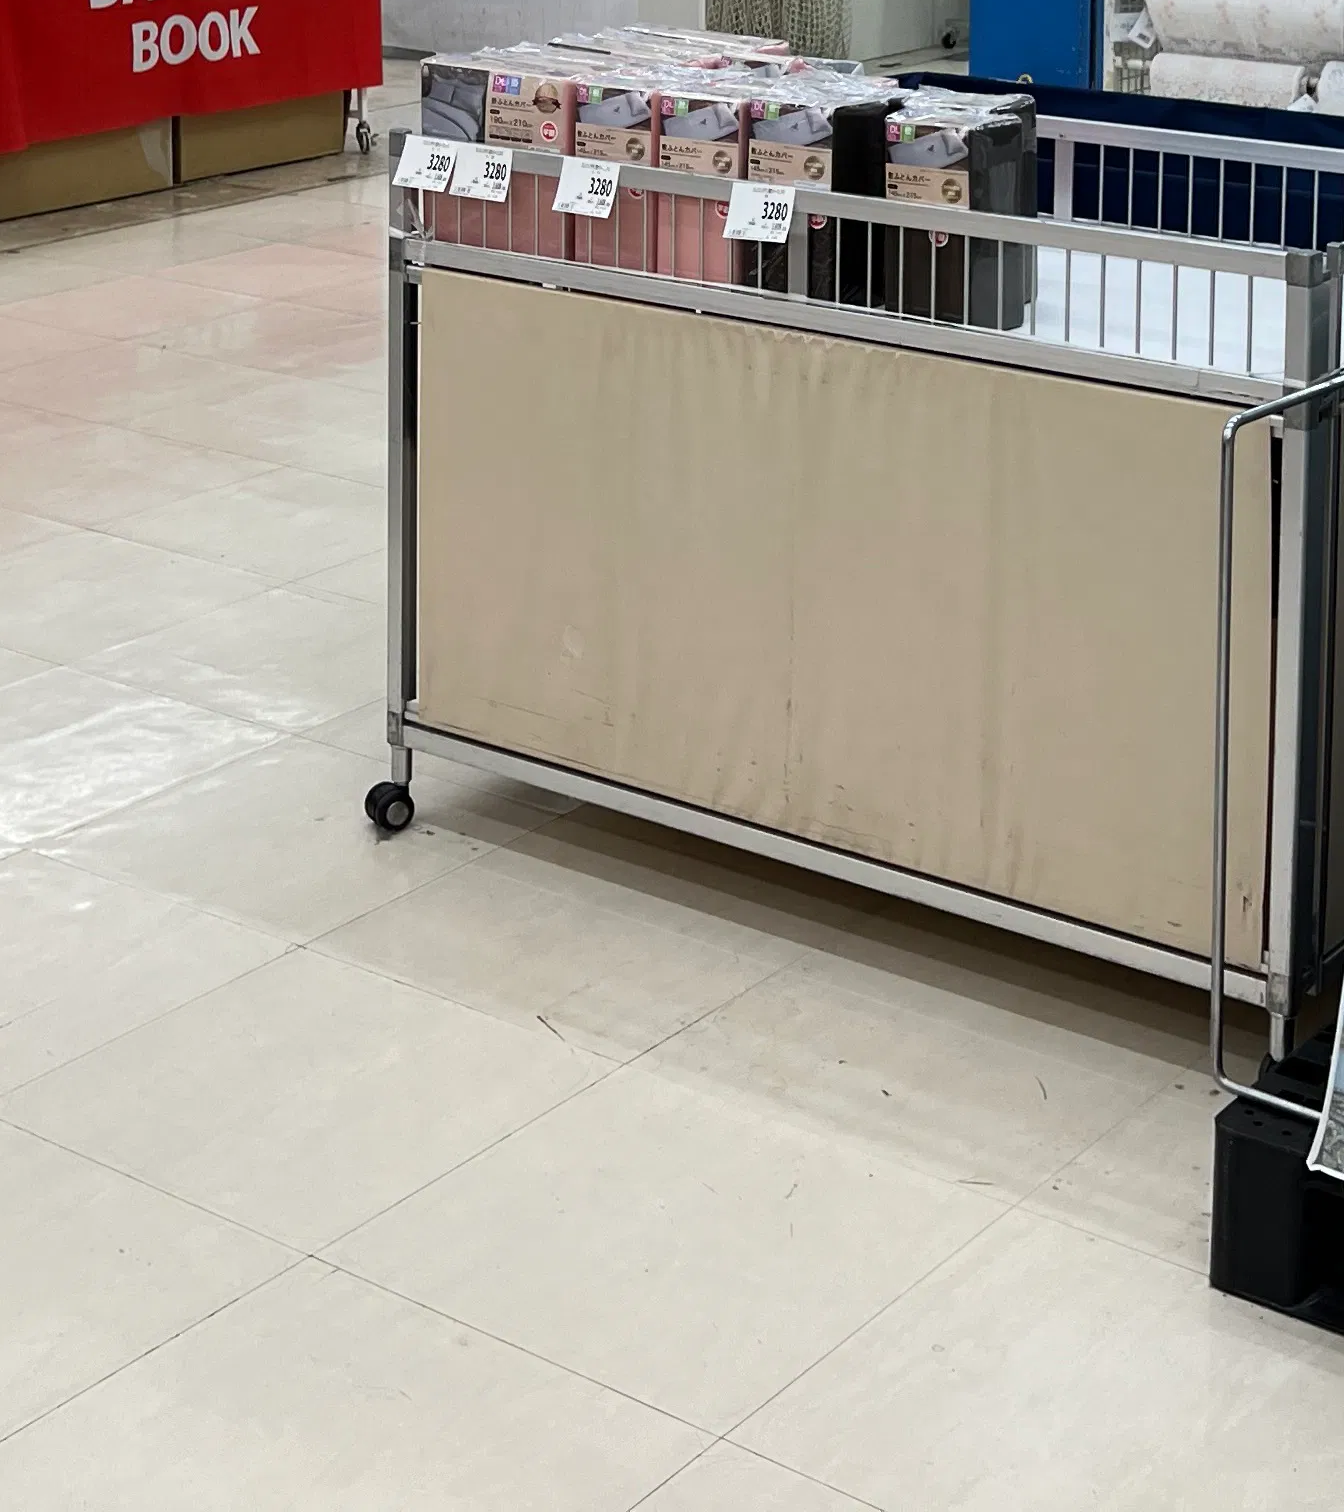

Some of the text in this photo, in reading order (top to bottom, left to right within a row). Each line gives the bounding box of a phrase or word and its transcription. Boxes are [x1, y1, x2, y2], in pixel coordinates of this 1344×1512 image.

[132, 6, 261, 73] BOOK
[427, 153, 451, 173] 3280
[483, 161, 507, 181] 3280
[587, 177, 613, 197] 3280
[761, 201, 788, 221] 3280
